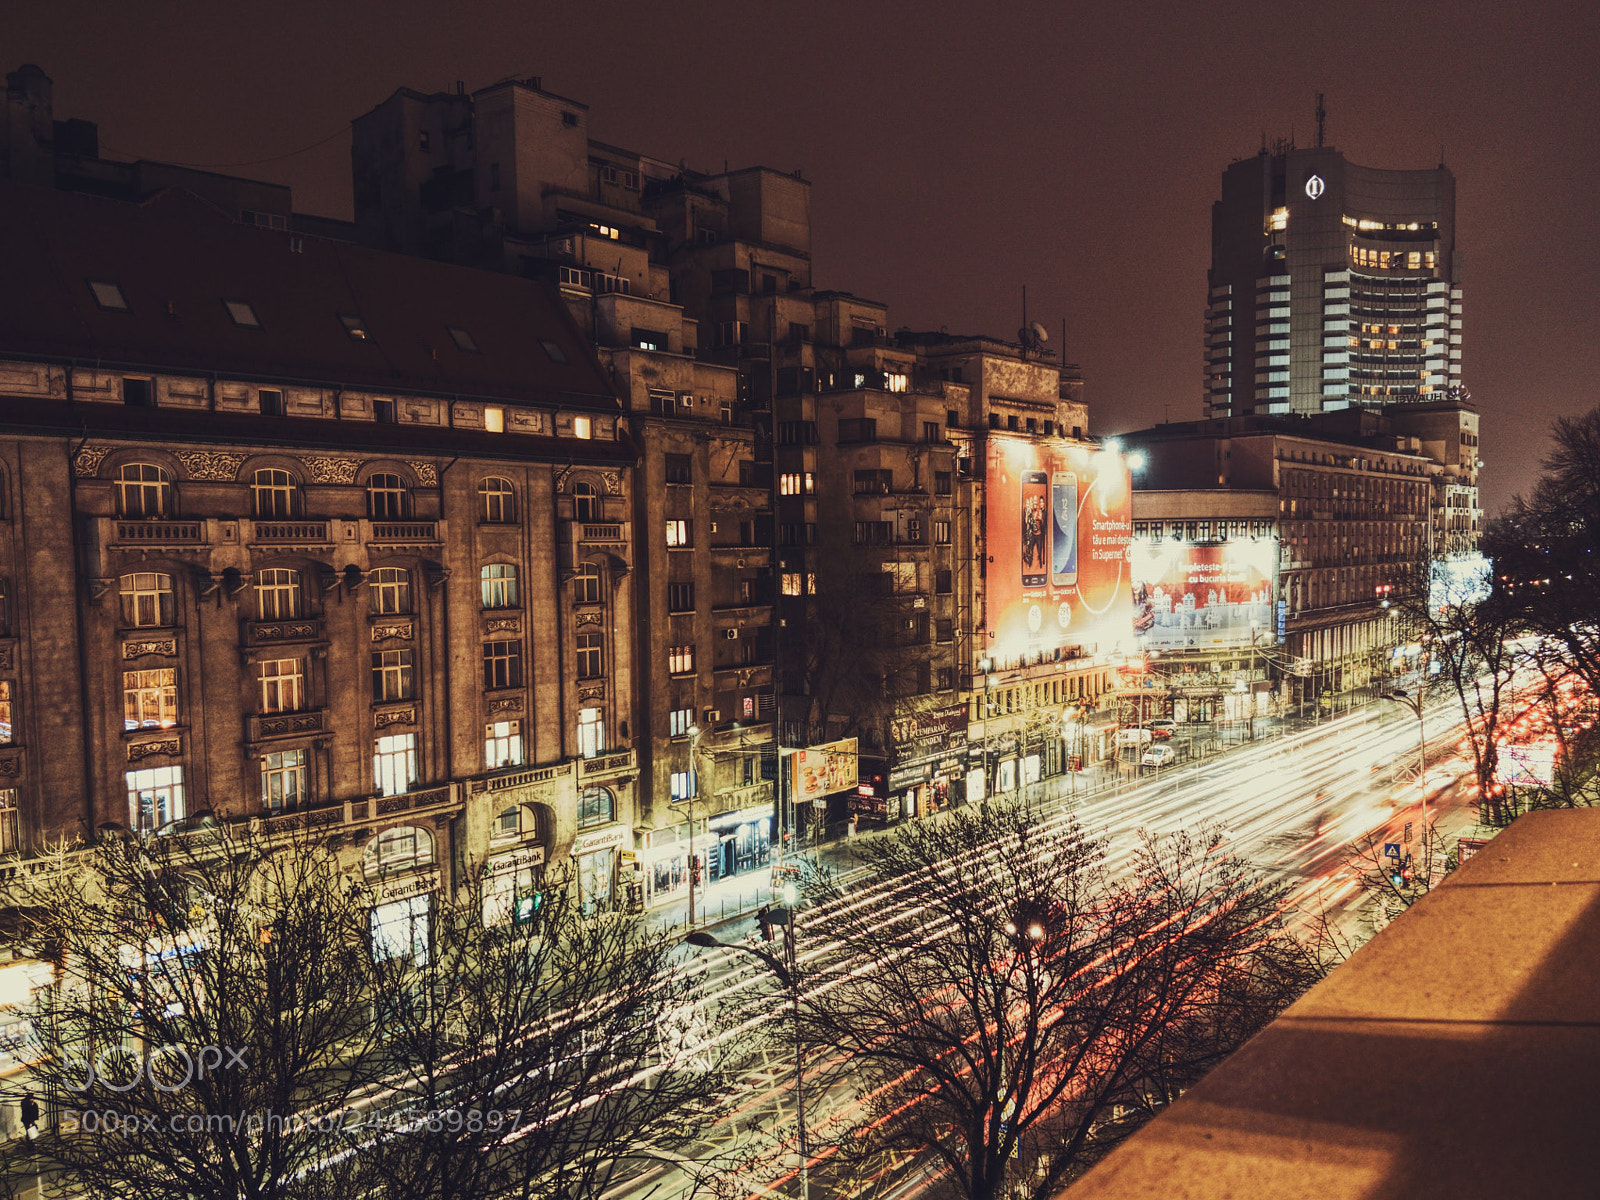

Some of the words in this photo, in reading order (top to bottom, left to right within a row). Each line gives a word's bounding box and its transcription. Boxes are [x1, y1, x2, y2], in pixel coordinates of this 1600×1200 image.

[1107, 534, 1116, 545] mai
[1188, 576, 1198, 584] cu
[1199, 574, 1226, 583] bucuria
[582, 832, 625, 849] GarantiBank
[492, 851, 543, 872] GarantiBank
